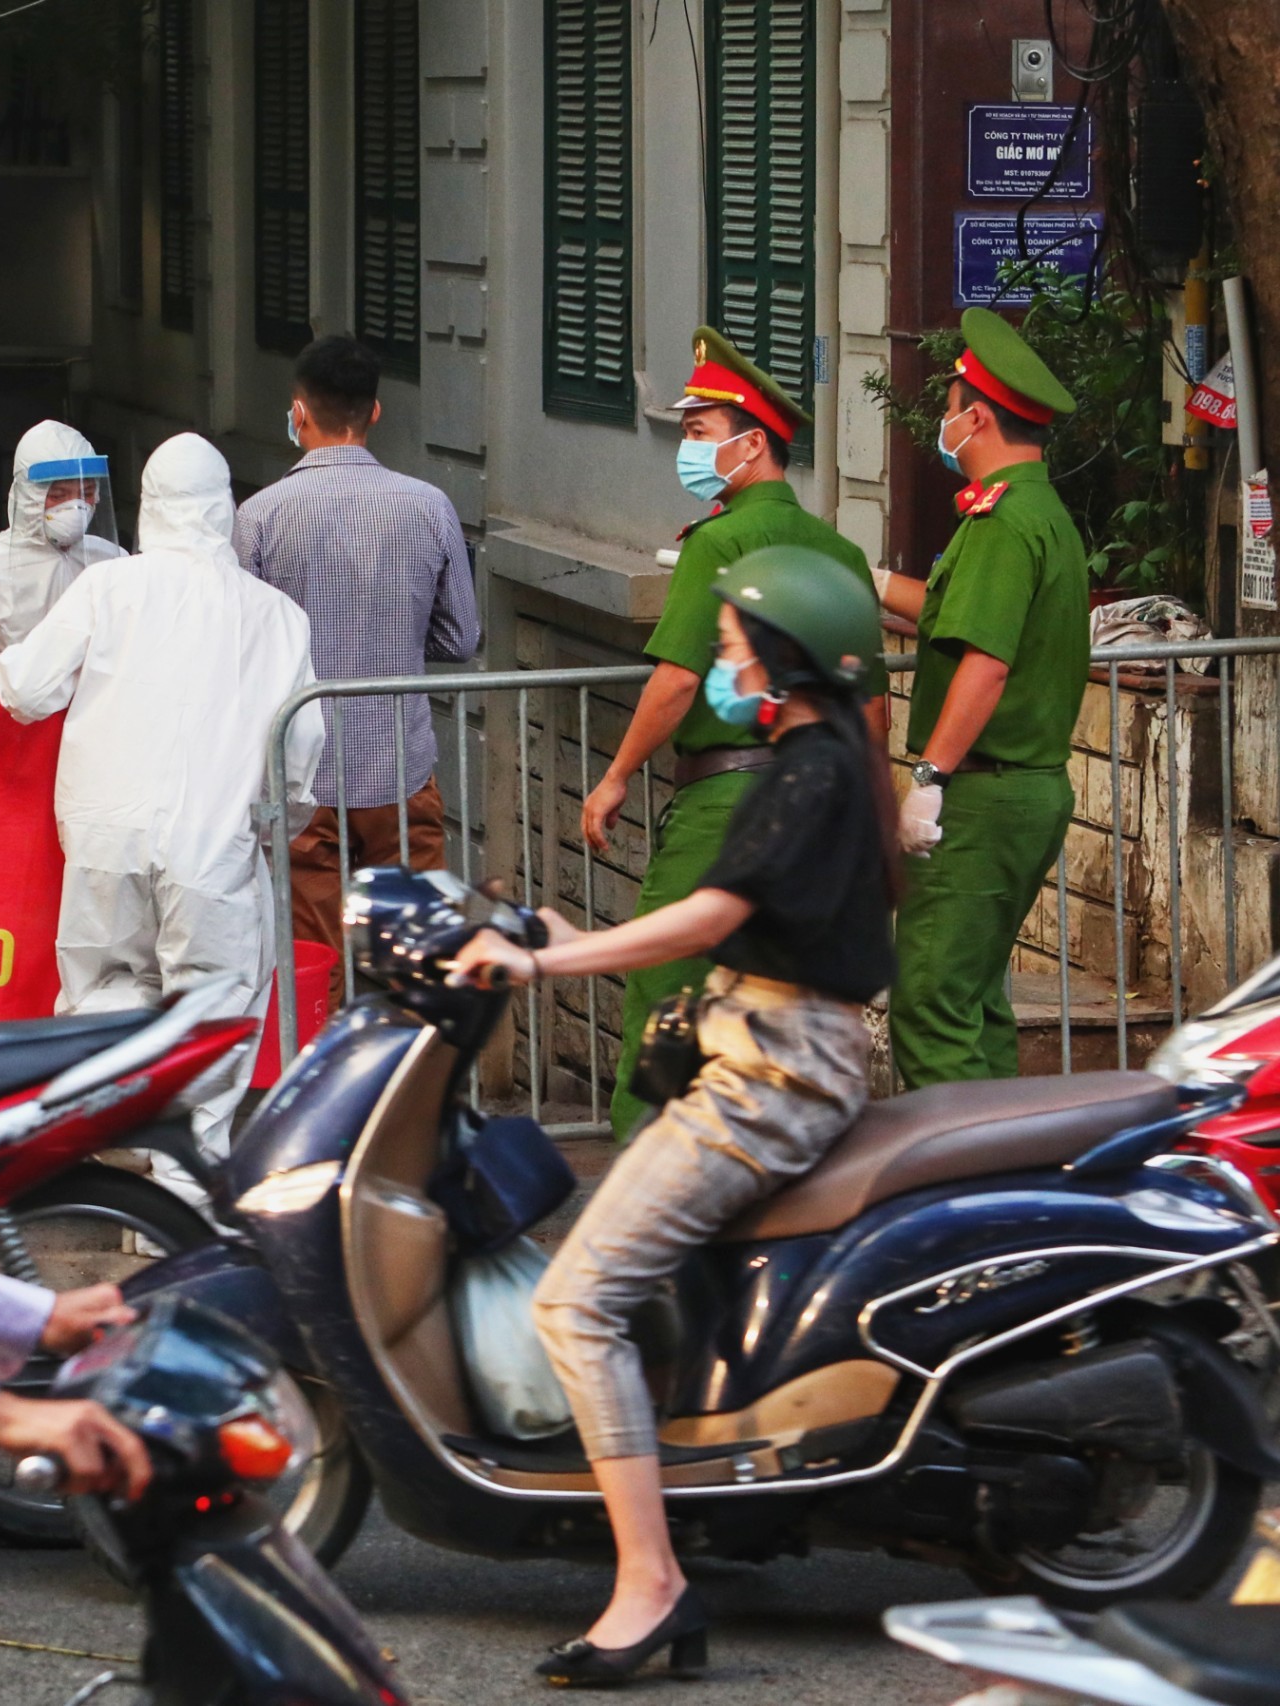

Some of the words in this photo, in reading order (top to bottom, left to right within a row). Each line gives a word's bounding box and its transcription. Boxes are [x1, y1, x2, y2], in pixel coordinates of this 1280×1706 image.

[984, 130, 1009, 140] CÔNG
[1010, 132, 1021, 140] TY
[996, 142, 1023, 160] GIÁC
[1025, 145, 1044, 160] MƠ
[971, 237, 993, 245] CÔNG
